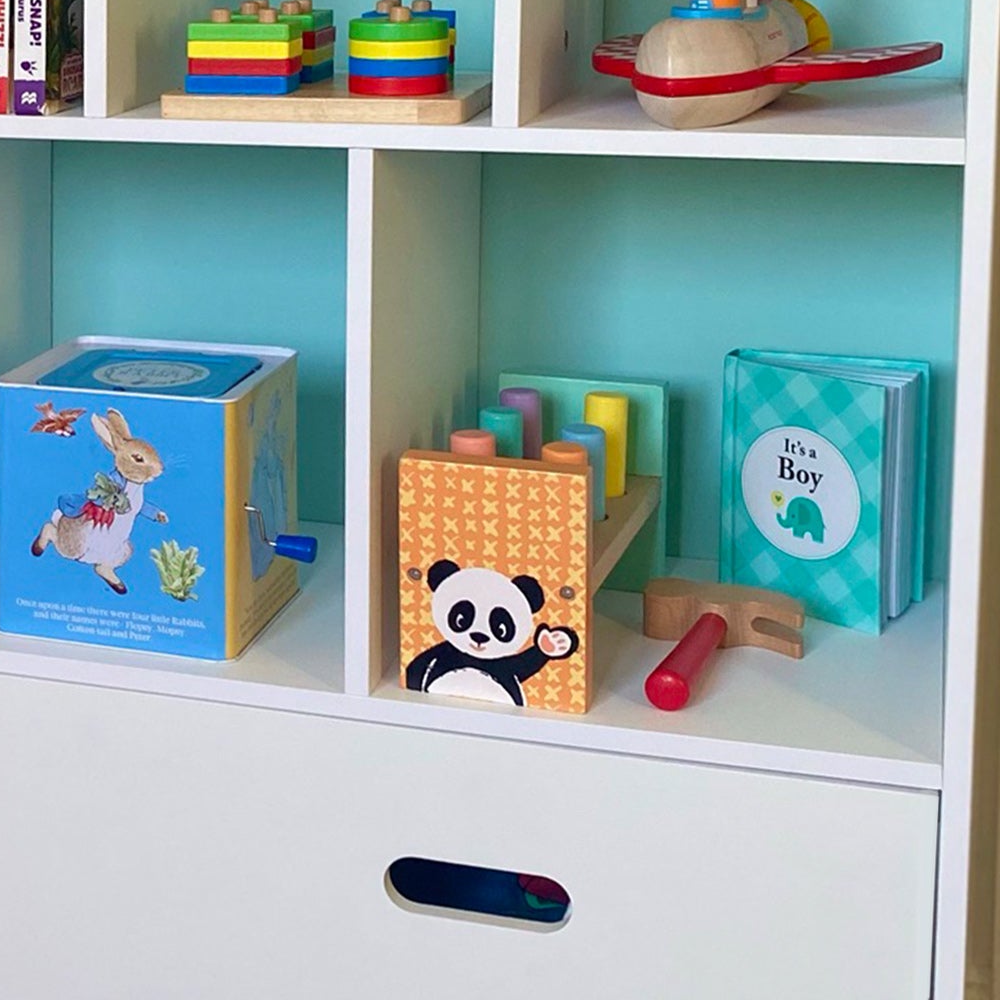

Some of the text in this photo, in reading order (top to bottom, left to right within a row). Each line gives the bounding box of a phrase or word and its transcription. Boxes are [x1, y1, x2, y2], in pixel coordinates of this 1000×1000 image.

[30, 0, 42, 46] SNAP!
[784, 438, 817, 459] It's a
[777, 455, 824, 494] Boy
